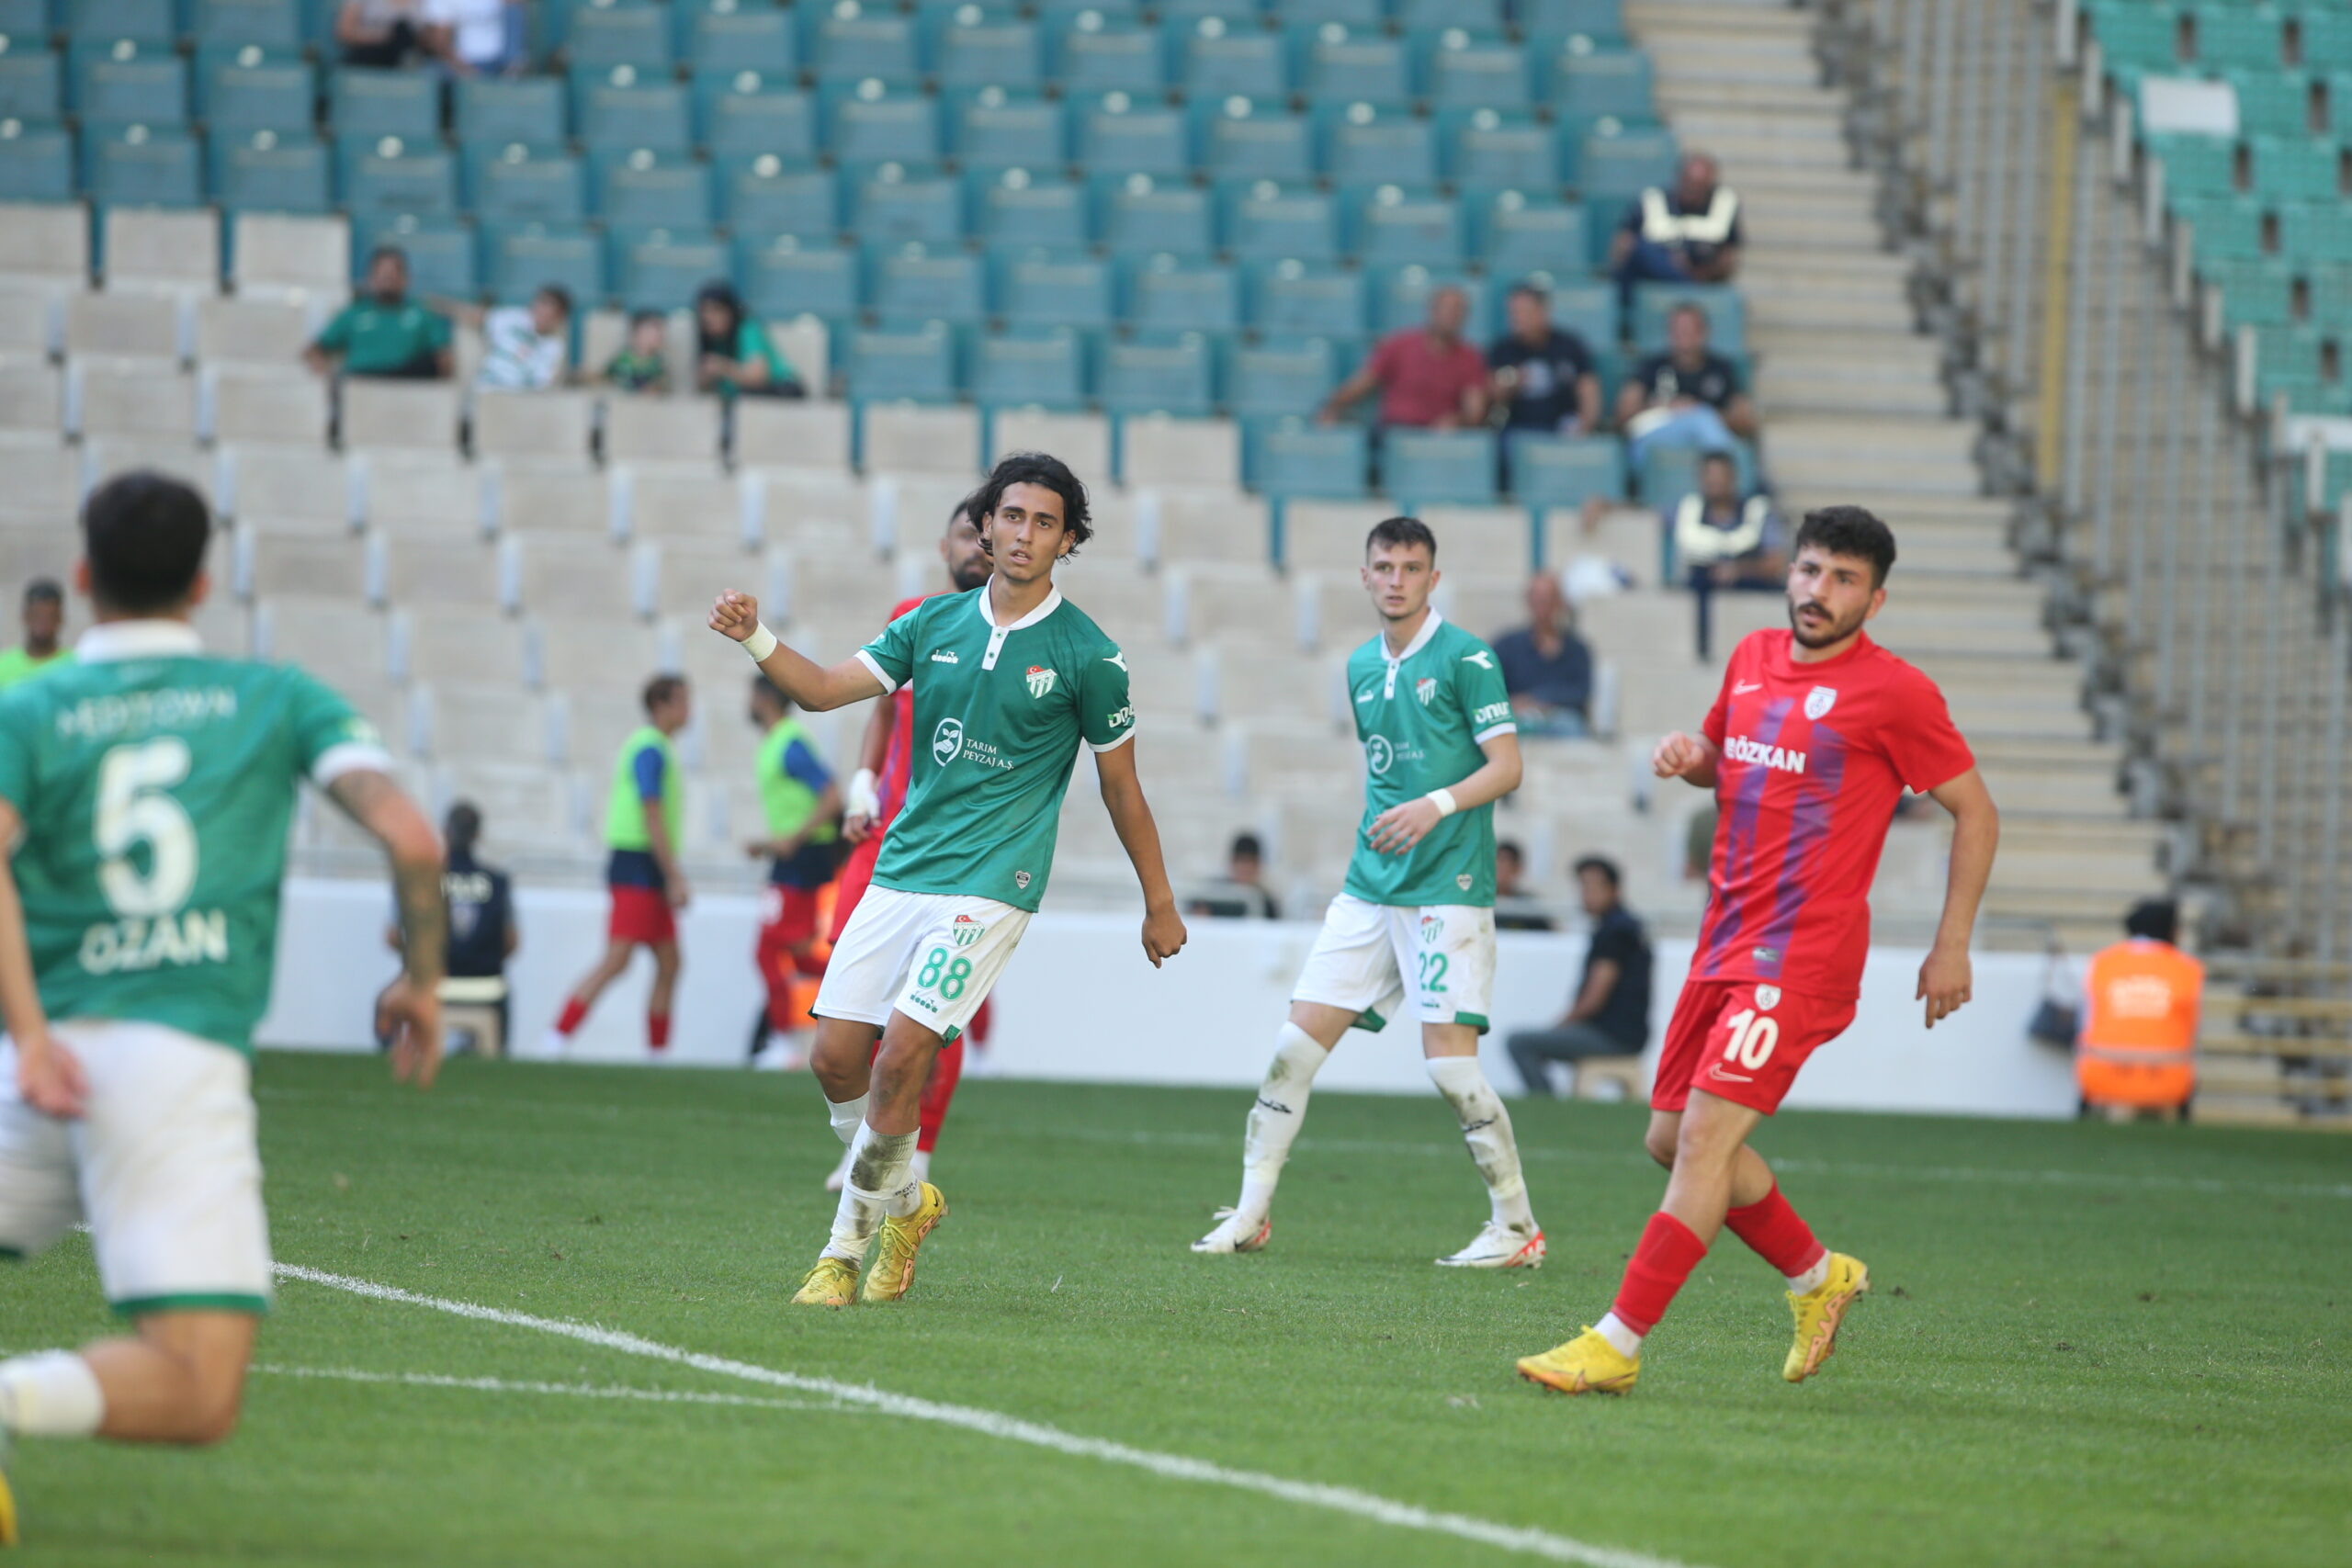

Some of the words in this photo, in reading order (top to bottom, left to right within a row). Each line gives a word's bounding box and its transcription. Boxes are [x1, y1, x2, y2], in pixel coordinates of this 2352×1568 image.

[963, 749, 996, 768] PEYZAJ
[966, 738, 998, 754] TARIM
[96, 735, 199, 917] 5
[78, 908, 229, 975] OZAN
[917, 947, 973, 1002] 88
[1723, 1008, 1780, 1070] 10
